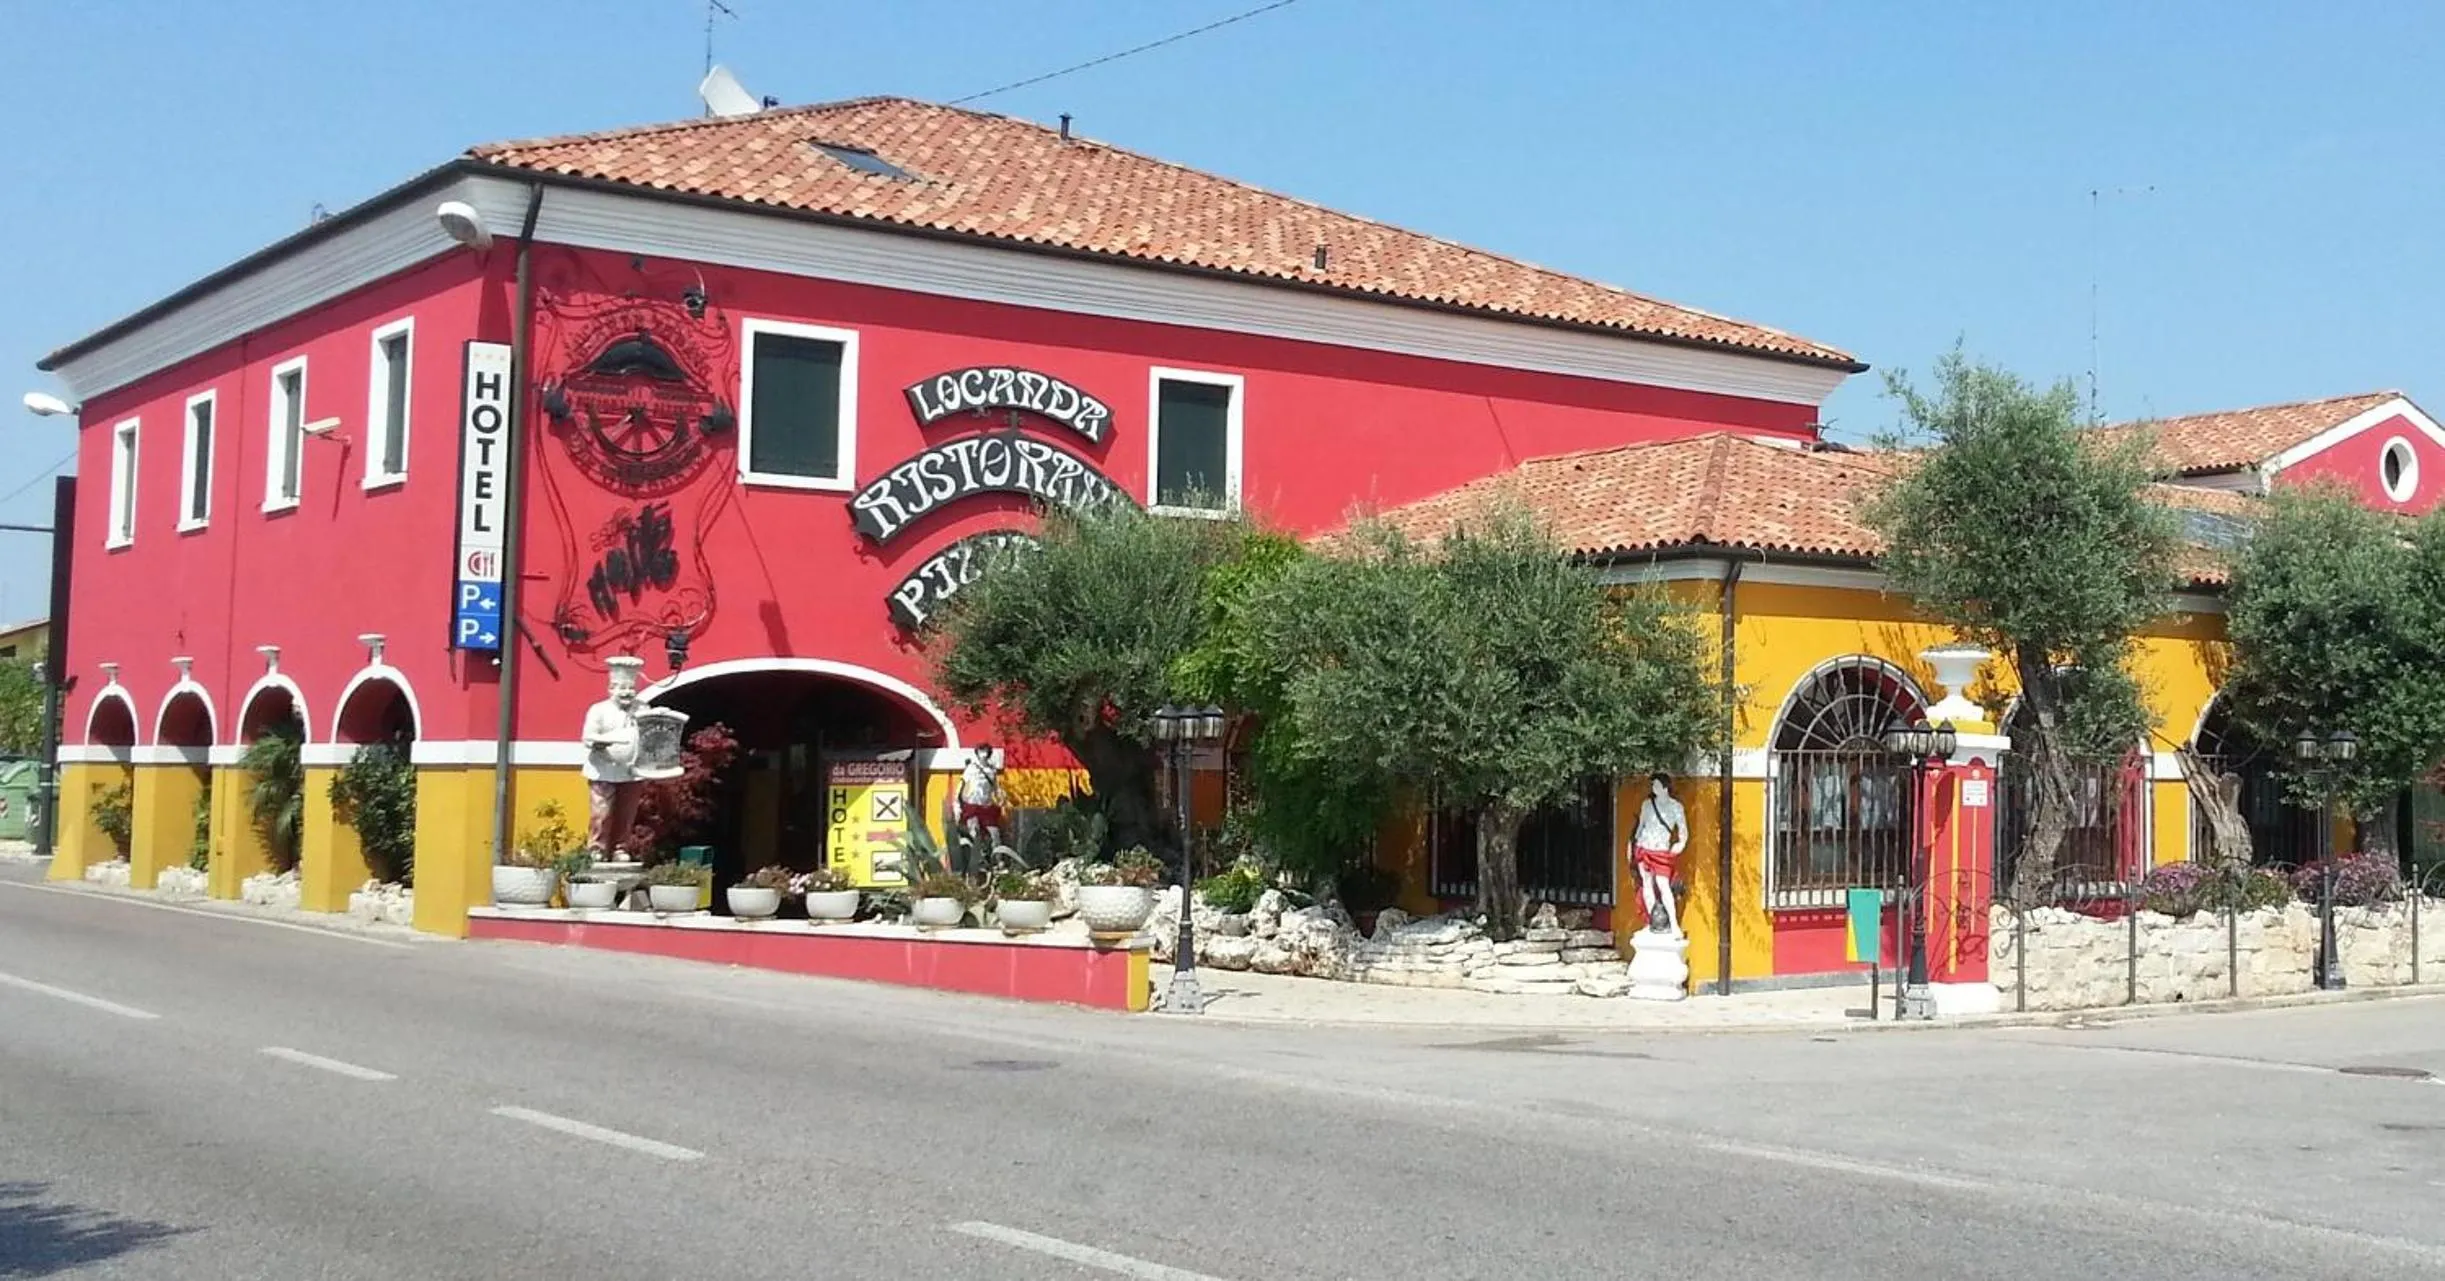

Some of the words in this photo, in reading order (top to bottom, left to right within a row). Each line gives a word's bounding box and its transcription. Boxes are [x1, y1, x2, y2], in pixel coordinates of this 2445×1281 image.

[910, 369, 1108, 441] LOCANDA
[471, 371, 502, 533] HOTEL
[854, 437, 1123, 538] RISTORAN
[459, 619, 480, 645] P
[461, 585, 481, 610] P
[832, 763, 845, 776] da
[847, 762, 905, 776] GREGORIO
[832, 788, 847, 864] HOTE
